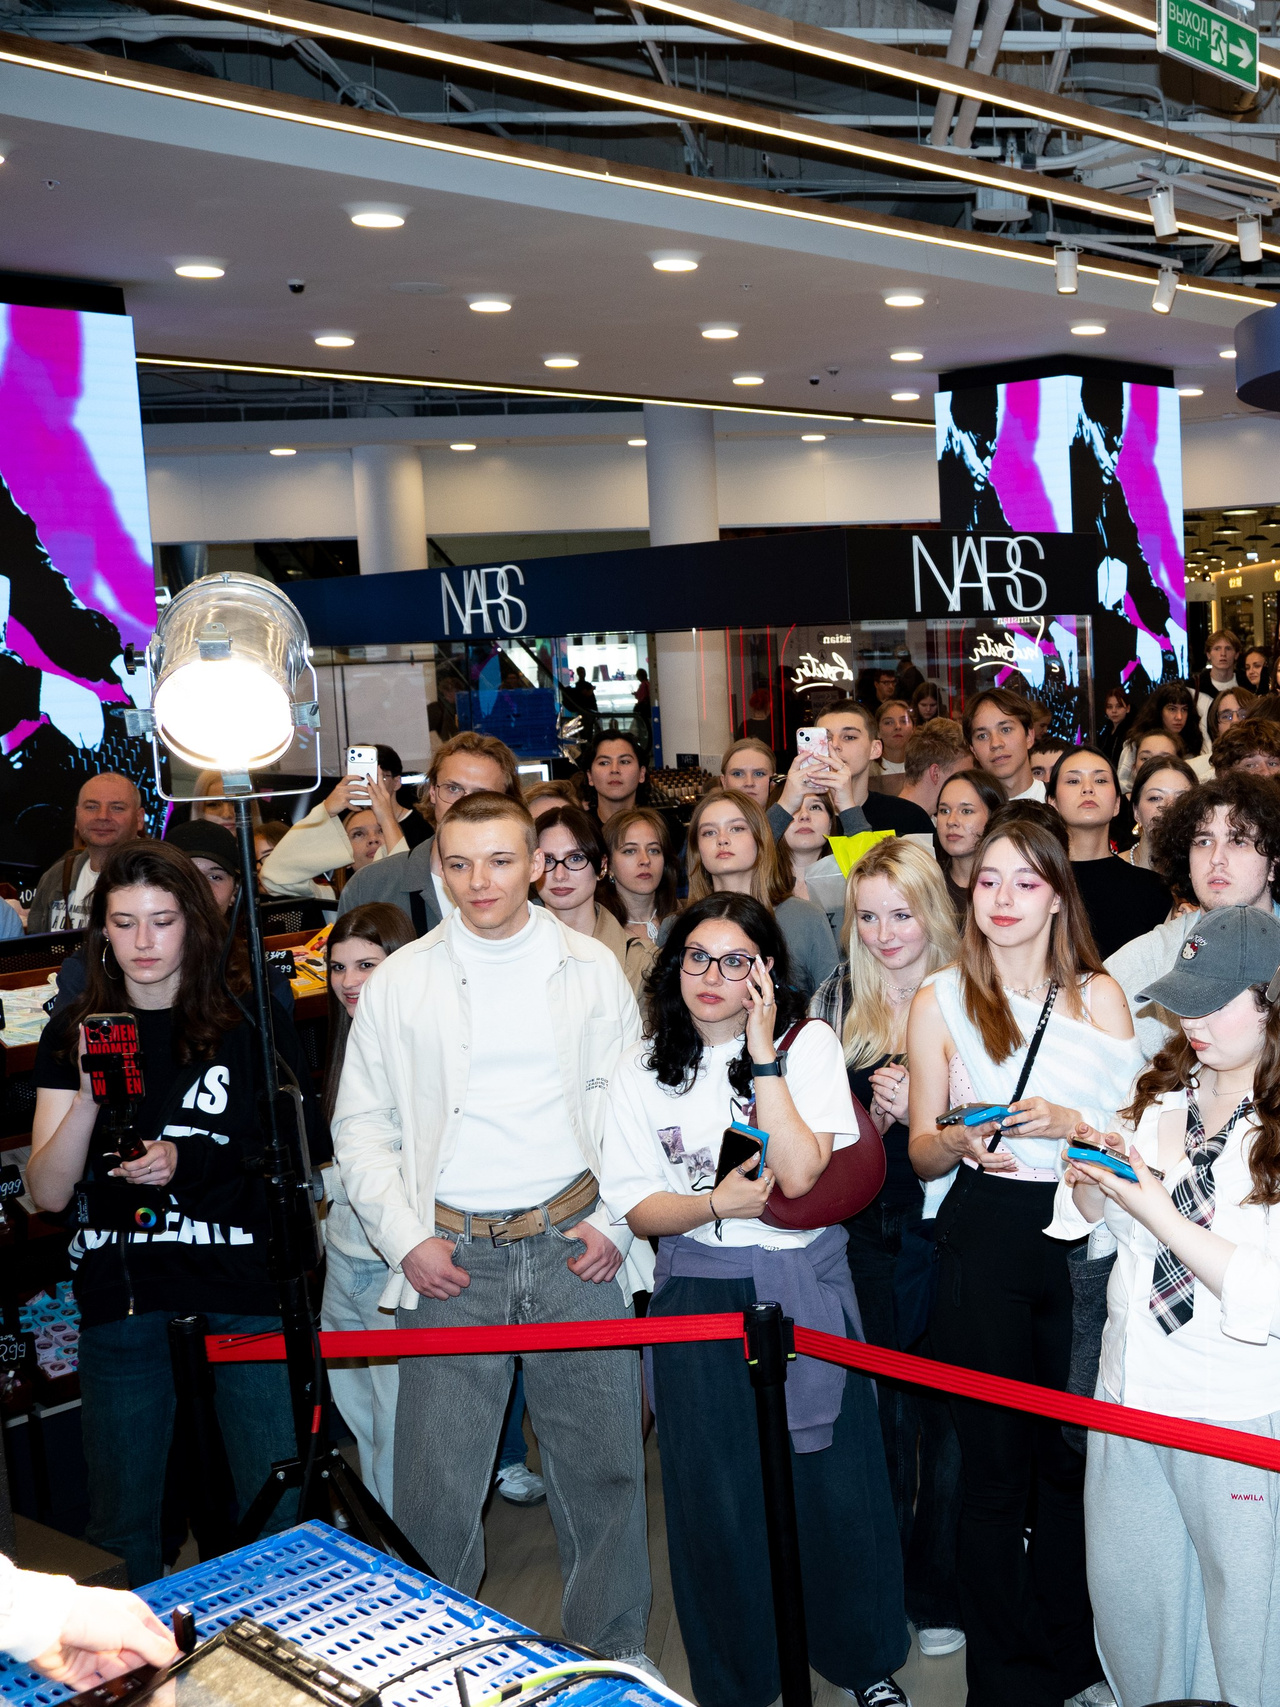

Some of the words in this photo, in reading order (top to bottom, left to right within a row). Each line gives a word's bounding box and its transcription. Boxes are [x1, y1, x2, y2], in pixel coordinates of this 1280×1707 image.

[1168, 1, 1209, 41] ВЫХОД
[1177, 30, 1202, 52] EXIT
[912, 535, 1047, 612] NARS
[440, 564, 527, 635] NARS
[92, 1078, 143, 1096] WEN
[1230, 1493, 1265, 1502] WAWILA
